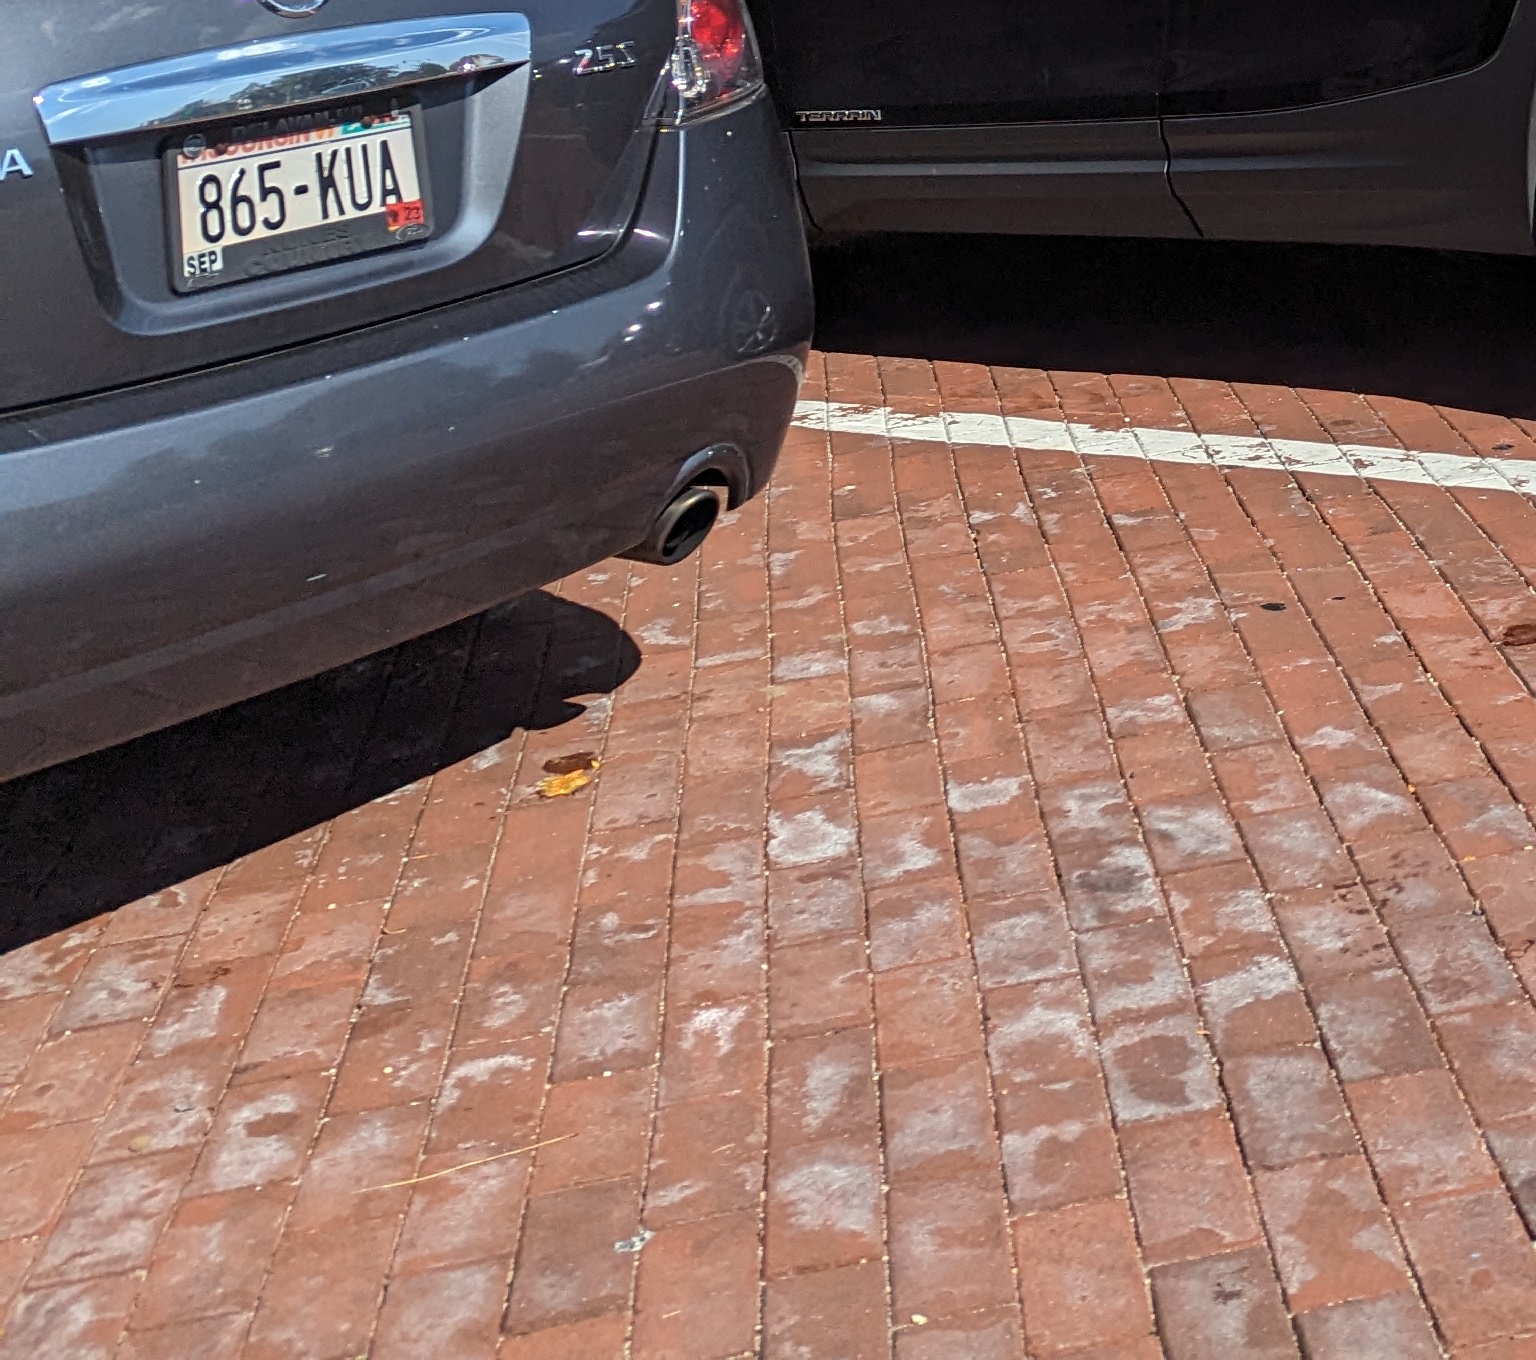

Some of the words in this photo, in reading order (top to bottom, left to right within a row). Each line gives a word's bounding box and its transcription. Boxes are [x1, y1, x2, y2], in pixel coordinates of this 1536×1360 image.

[795, 109, 883, 122] TERRAIN
[198, 138, 403, 244] 865-KUA
[186, 249, 219, 276] SEP
